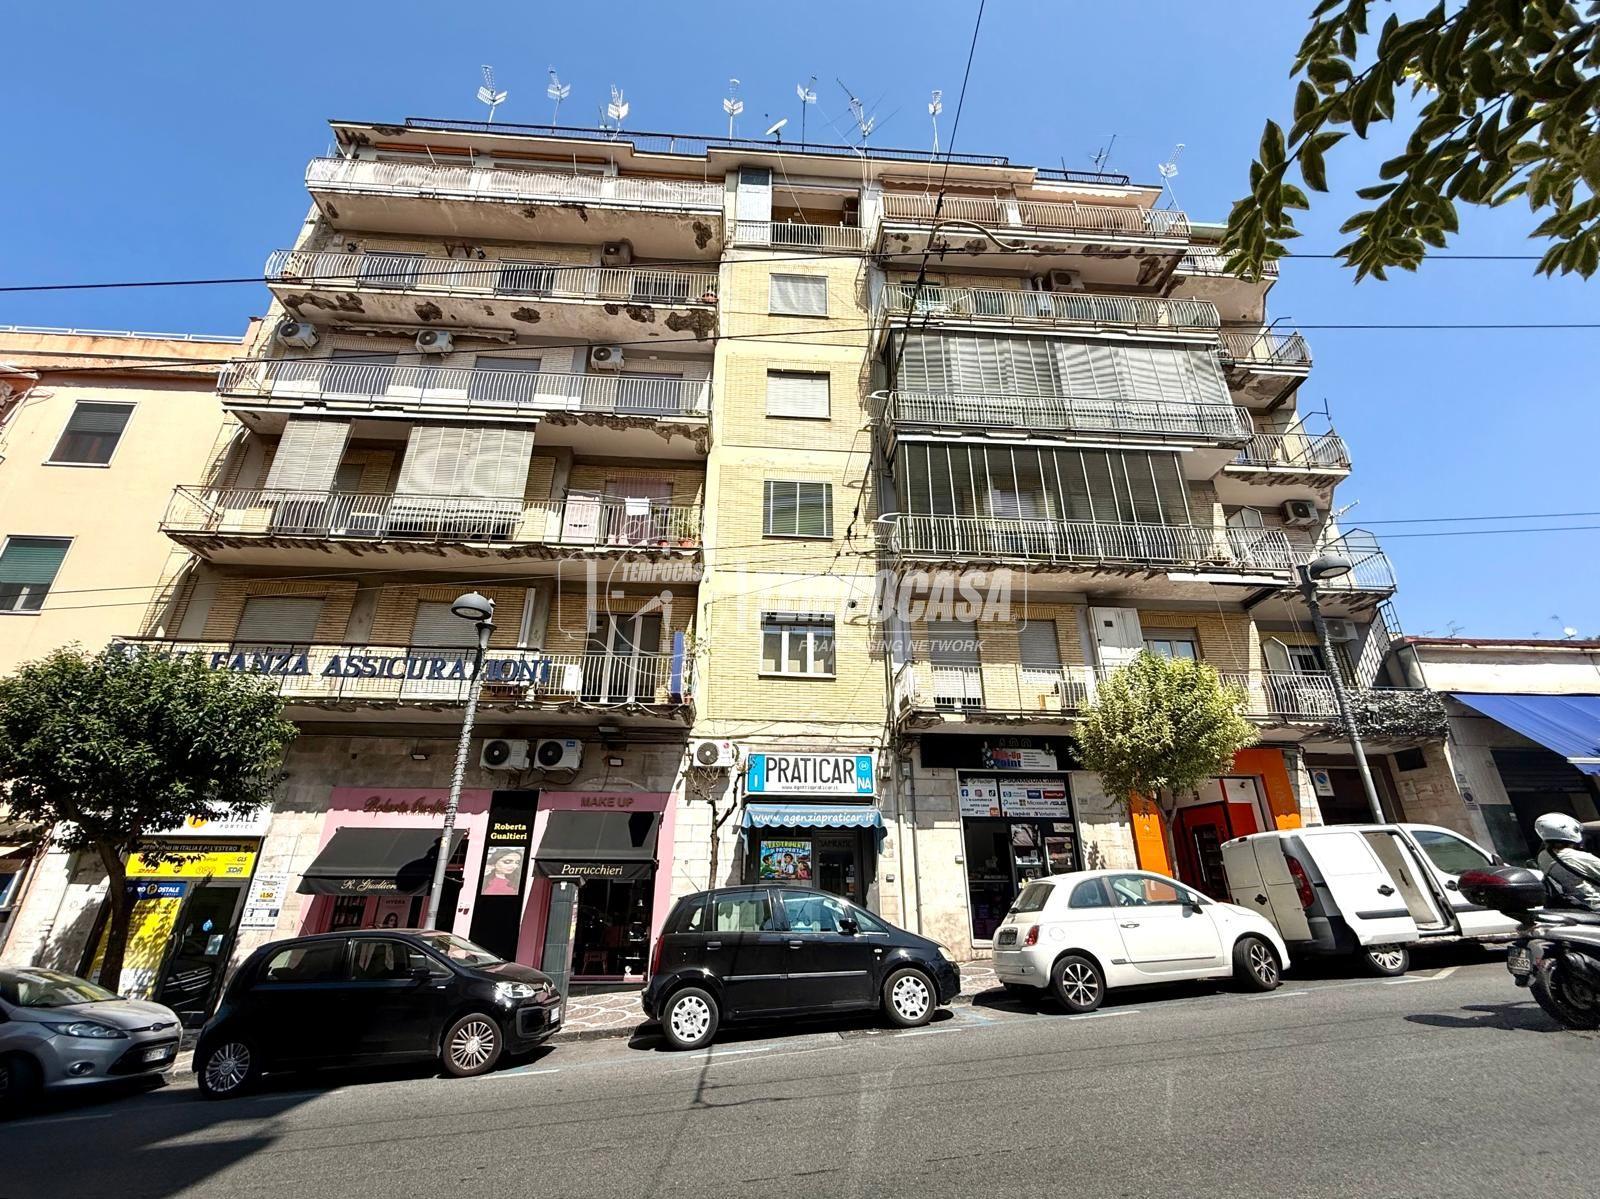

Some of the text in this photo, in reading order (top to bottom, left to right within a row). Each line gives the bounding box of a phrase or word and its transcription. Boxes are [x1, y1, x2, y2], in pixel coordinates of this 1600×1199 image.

[322, 654, 552, 683] ASSICURAIONI
[765, 757, 855, 784] PRATICAR
[857, 777, 872, 790] NA
[581, 797, 634, 808] MAKE UP
[494, 822, 527, 831] Roberta
[490, 832, 528, 840] Gualtieri
[561, 864, 623, 875] Parrucchieri
